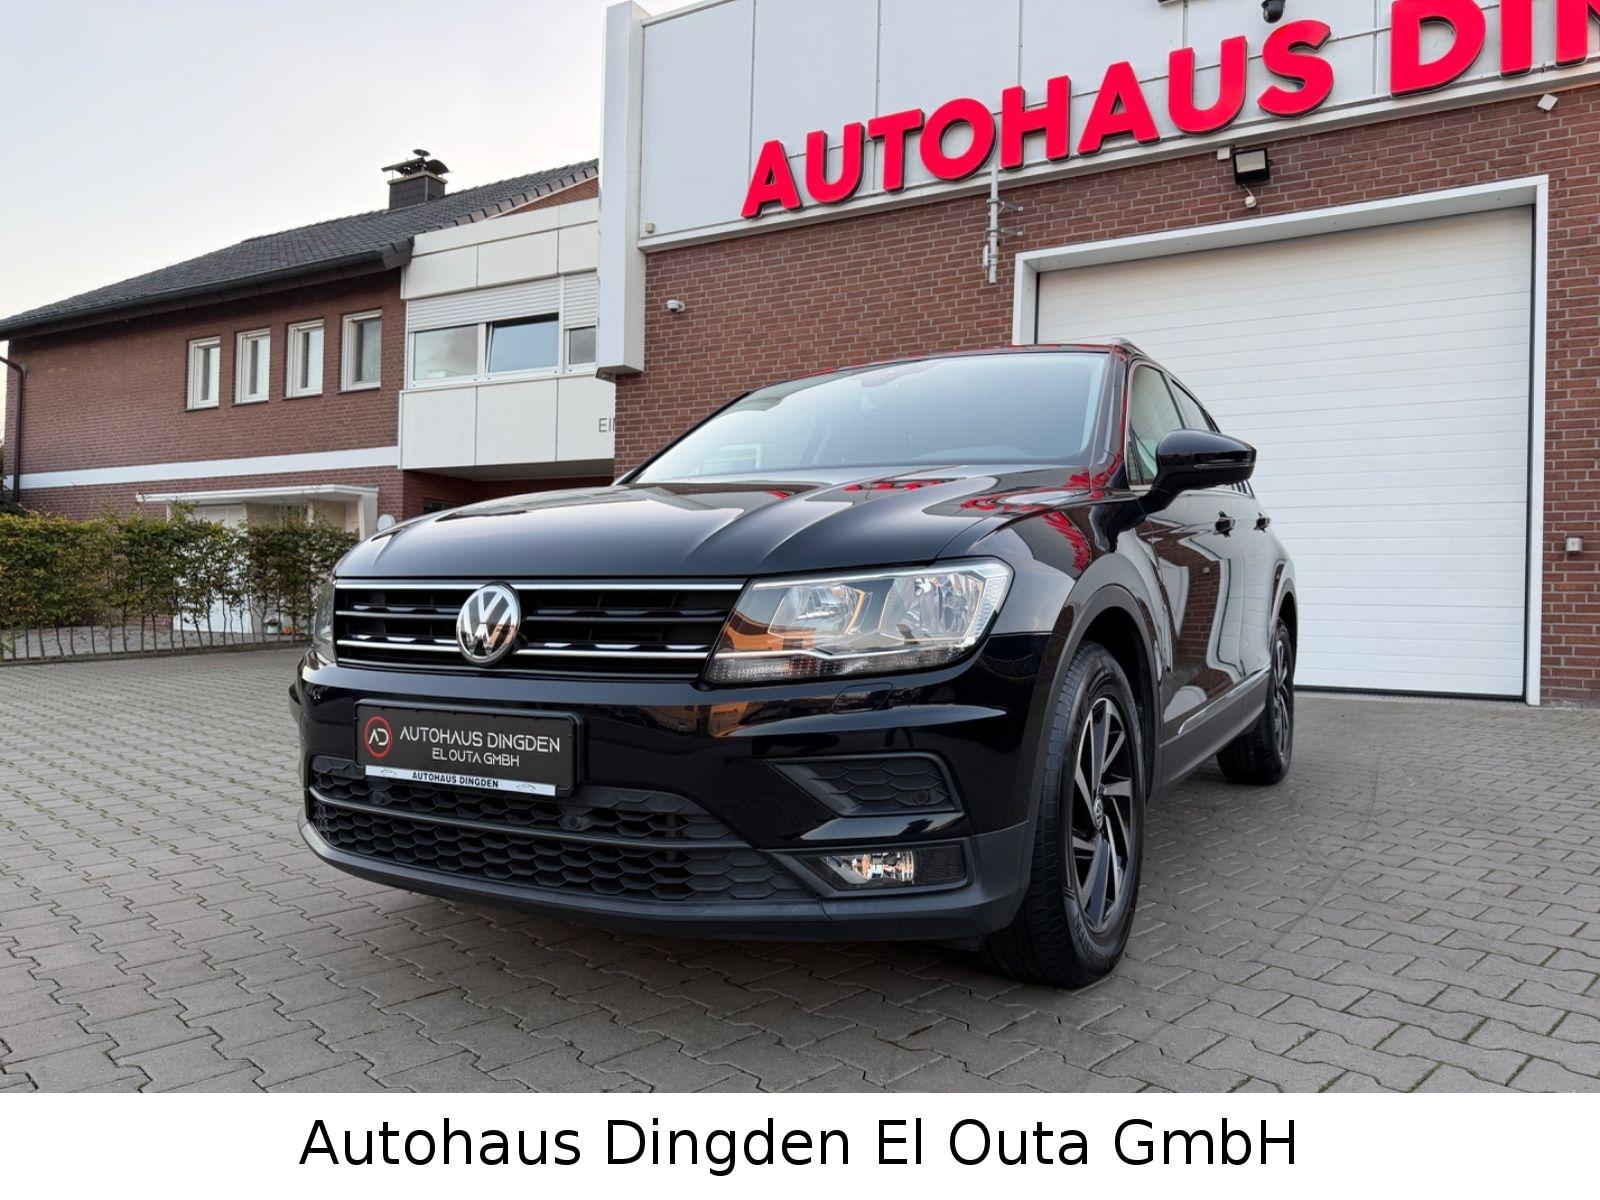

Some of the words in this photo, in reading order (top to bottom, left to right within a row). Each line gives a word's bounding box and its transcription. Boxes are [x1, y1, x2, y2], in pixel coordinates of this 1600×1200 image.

[741, 19, 1336, 219] AUTOHAUS
[458, 584, 519, 660] VW
[400, 726, 482, 748] AUTOHAUS
[487, 732, 560, 753] DINGDEN
[432, 748, 447, 760] EL
[449, 750, 481, 764] OUTA
[483, 753, 519, 767] GMBH
[412, 772, 457, 785] AUTOHAUS
[459, 776, 499, 789] DINGDEN
